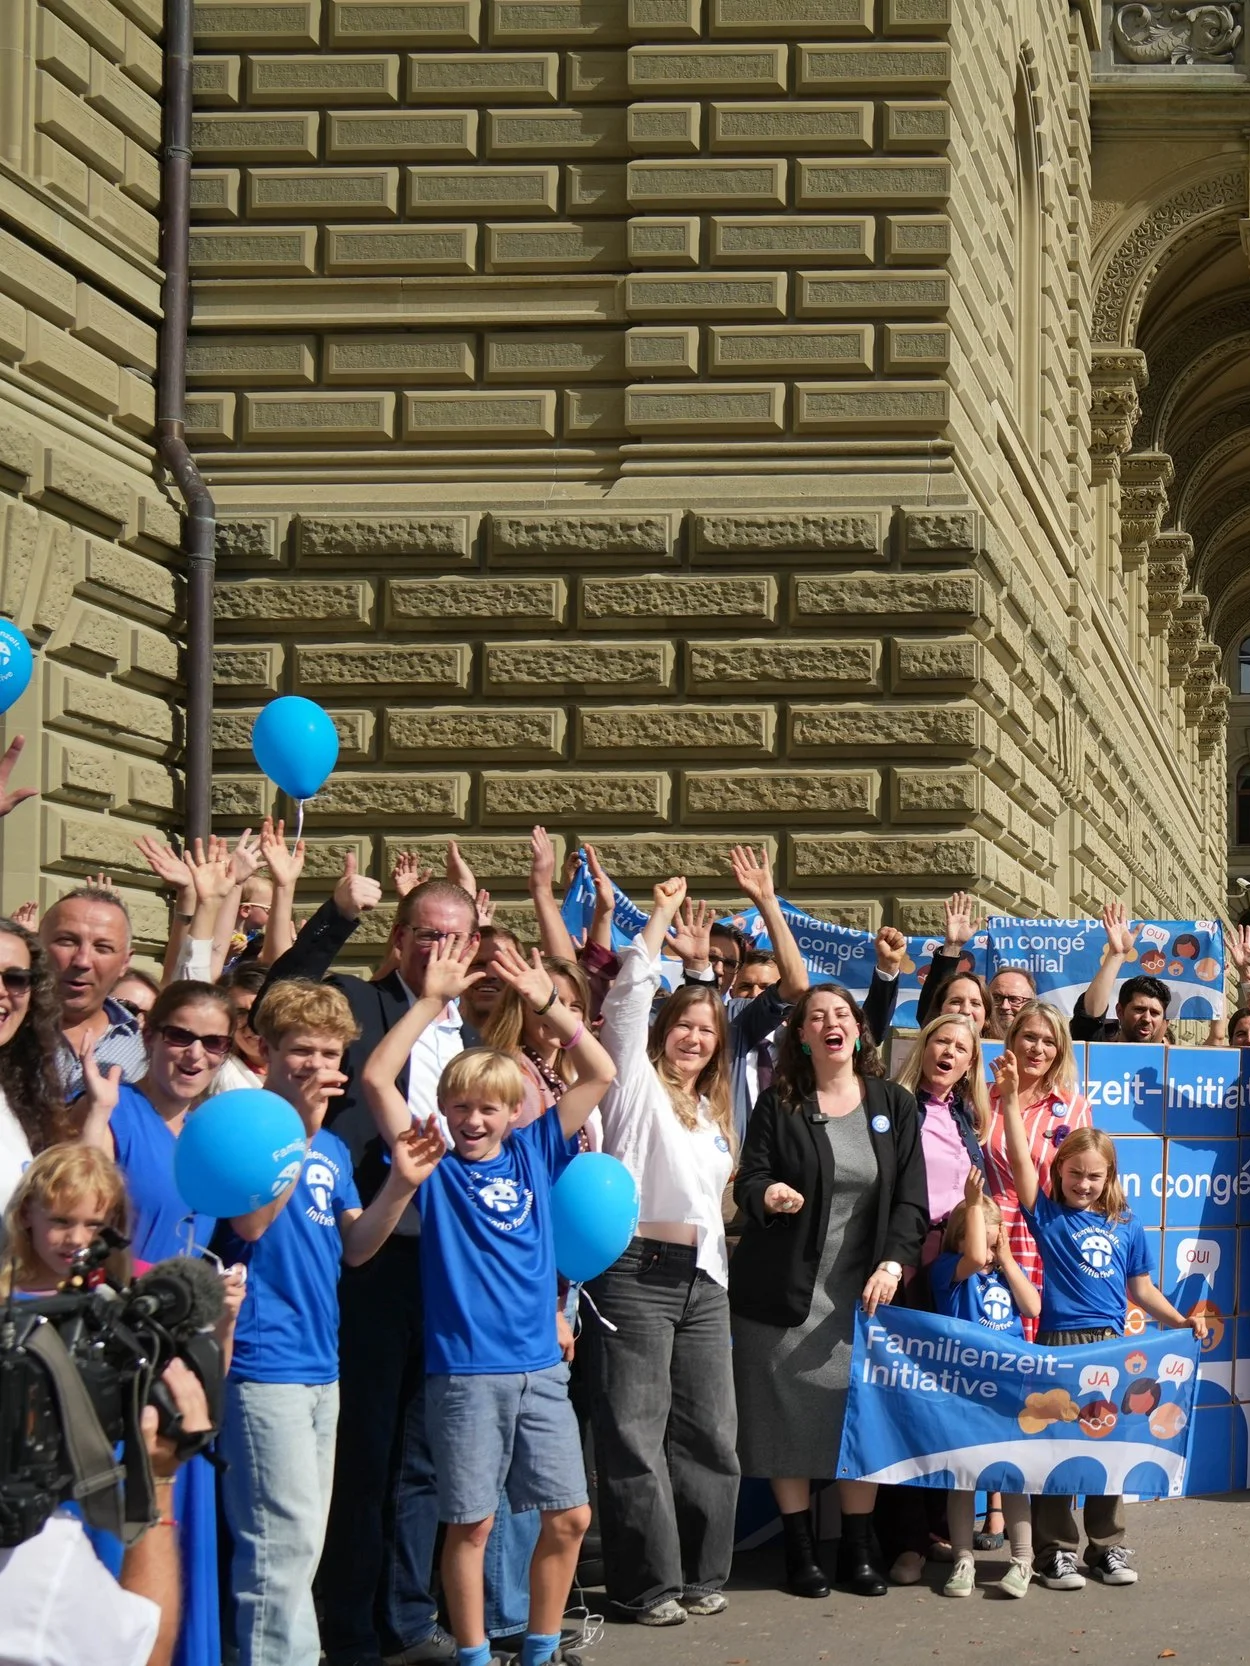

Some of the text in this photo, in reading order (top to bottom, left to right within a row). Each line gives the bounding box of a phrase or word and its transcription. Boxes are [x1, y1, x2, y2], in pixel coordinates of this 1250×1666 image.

[1017, 930, 1085, 955] congé
[1146, 927, 1166, 942] OUI
[798, 936, 866, 961] congé
[1186, 1249, 1210, 1264] OUI
[1165, 1360, 1185, 1377] JA
[862, 1357, 998, 1398] Initiative
[1088, 1371, 1111, 1387] JA
